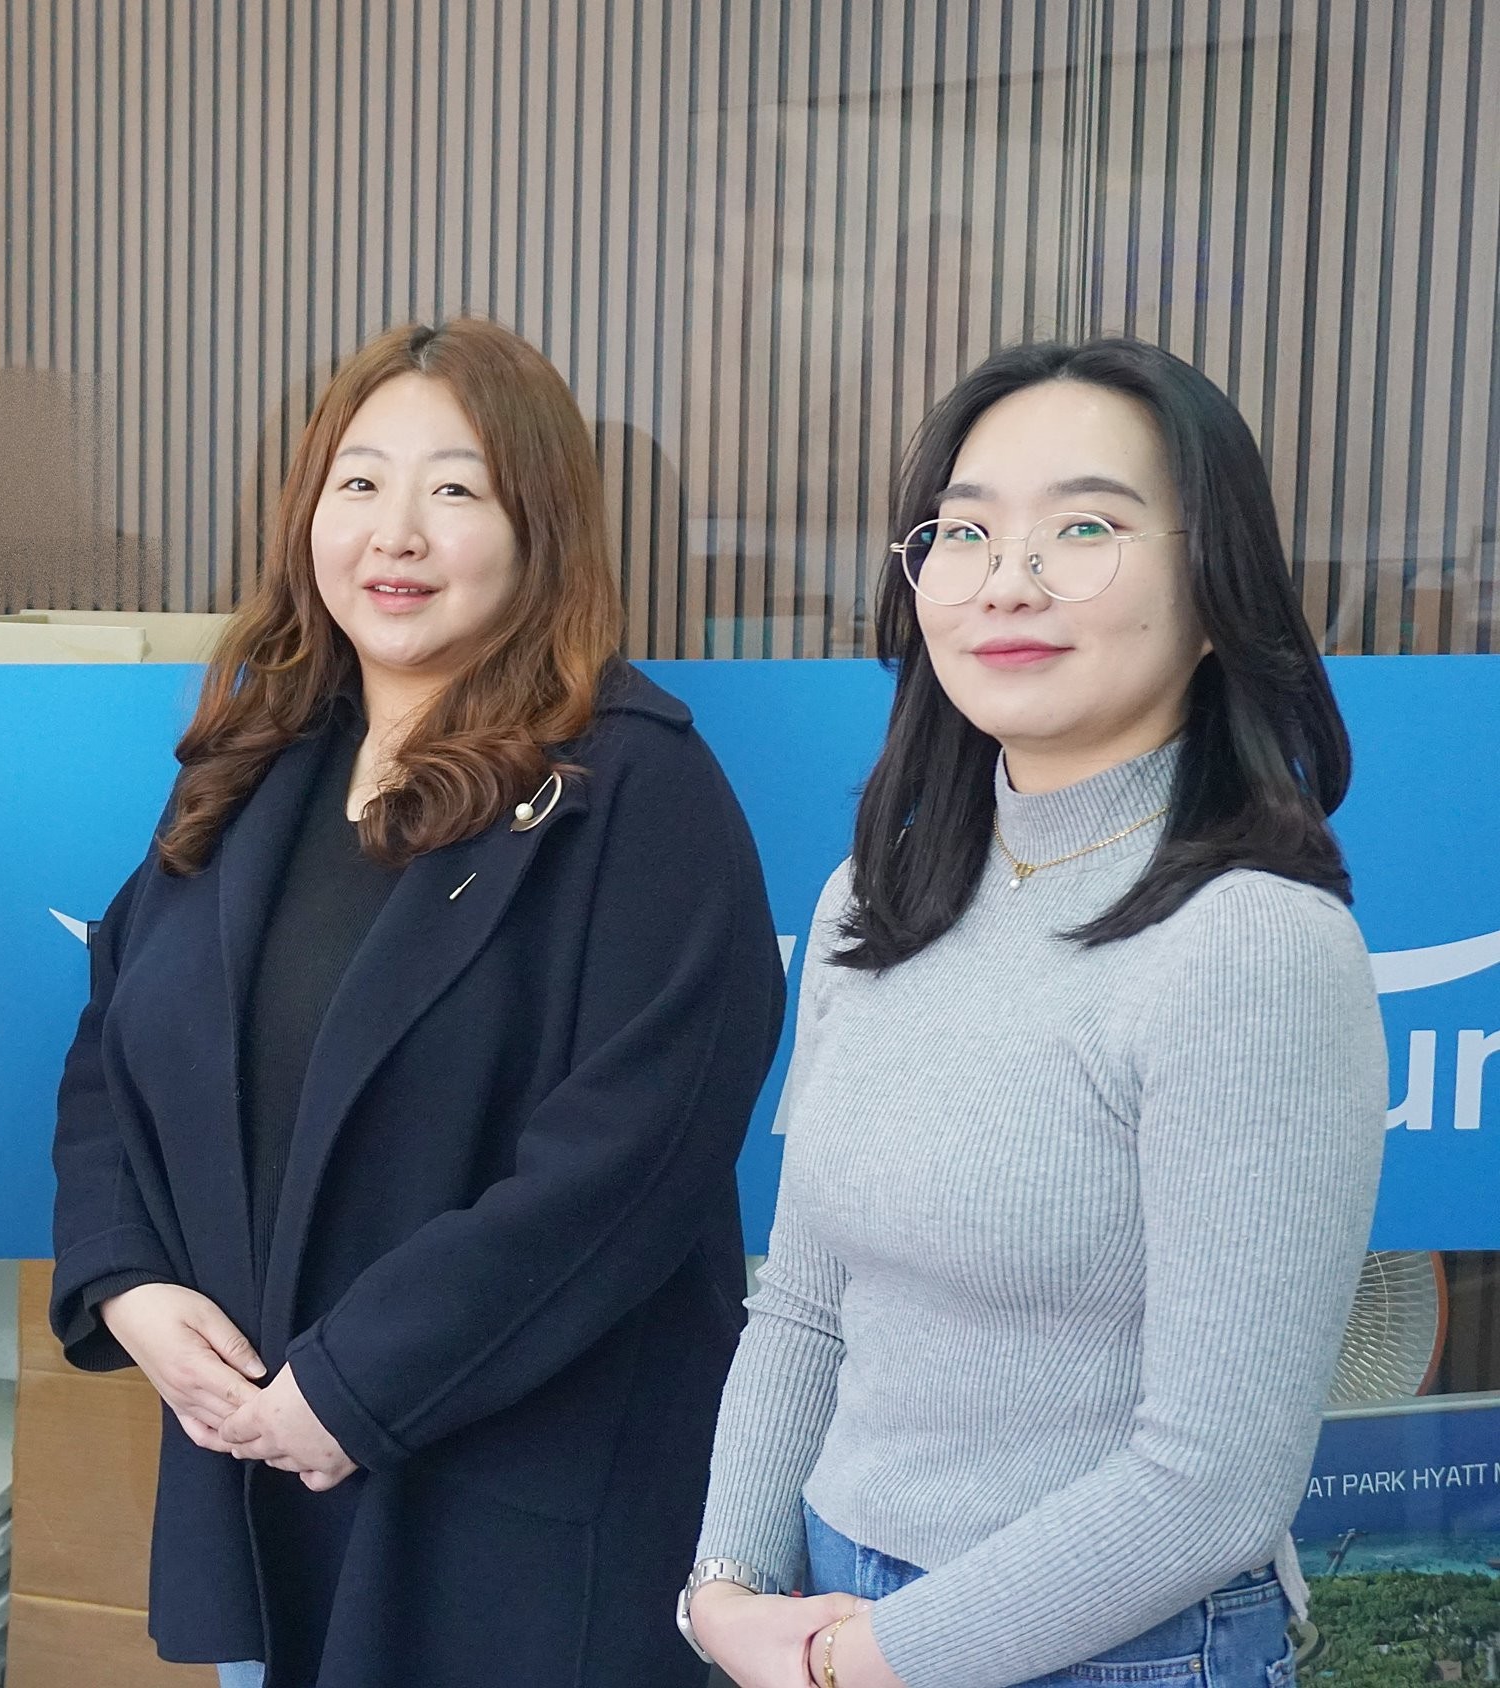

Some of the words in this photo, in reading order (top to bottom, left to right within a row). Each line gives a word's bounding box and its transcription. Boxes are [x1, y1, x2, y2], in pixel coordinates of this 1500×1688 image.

[1307, 1476, 1335, 1499] AT
[1343, 1470, 1407, 1496] PARK
[1413, 1463, 1488, 1490] HYATT
